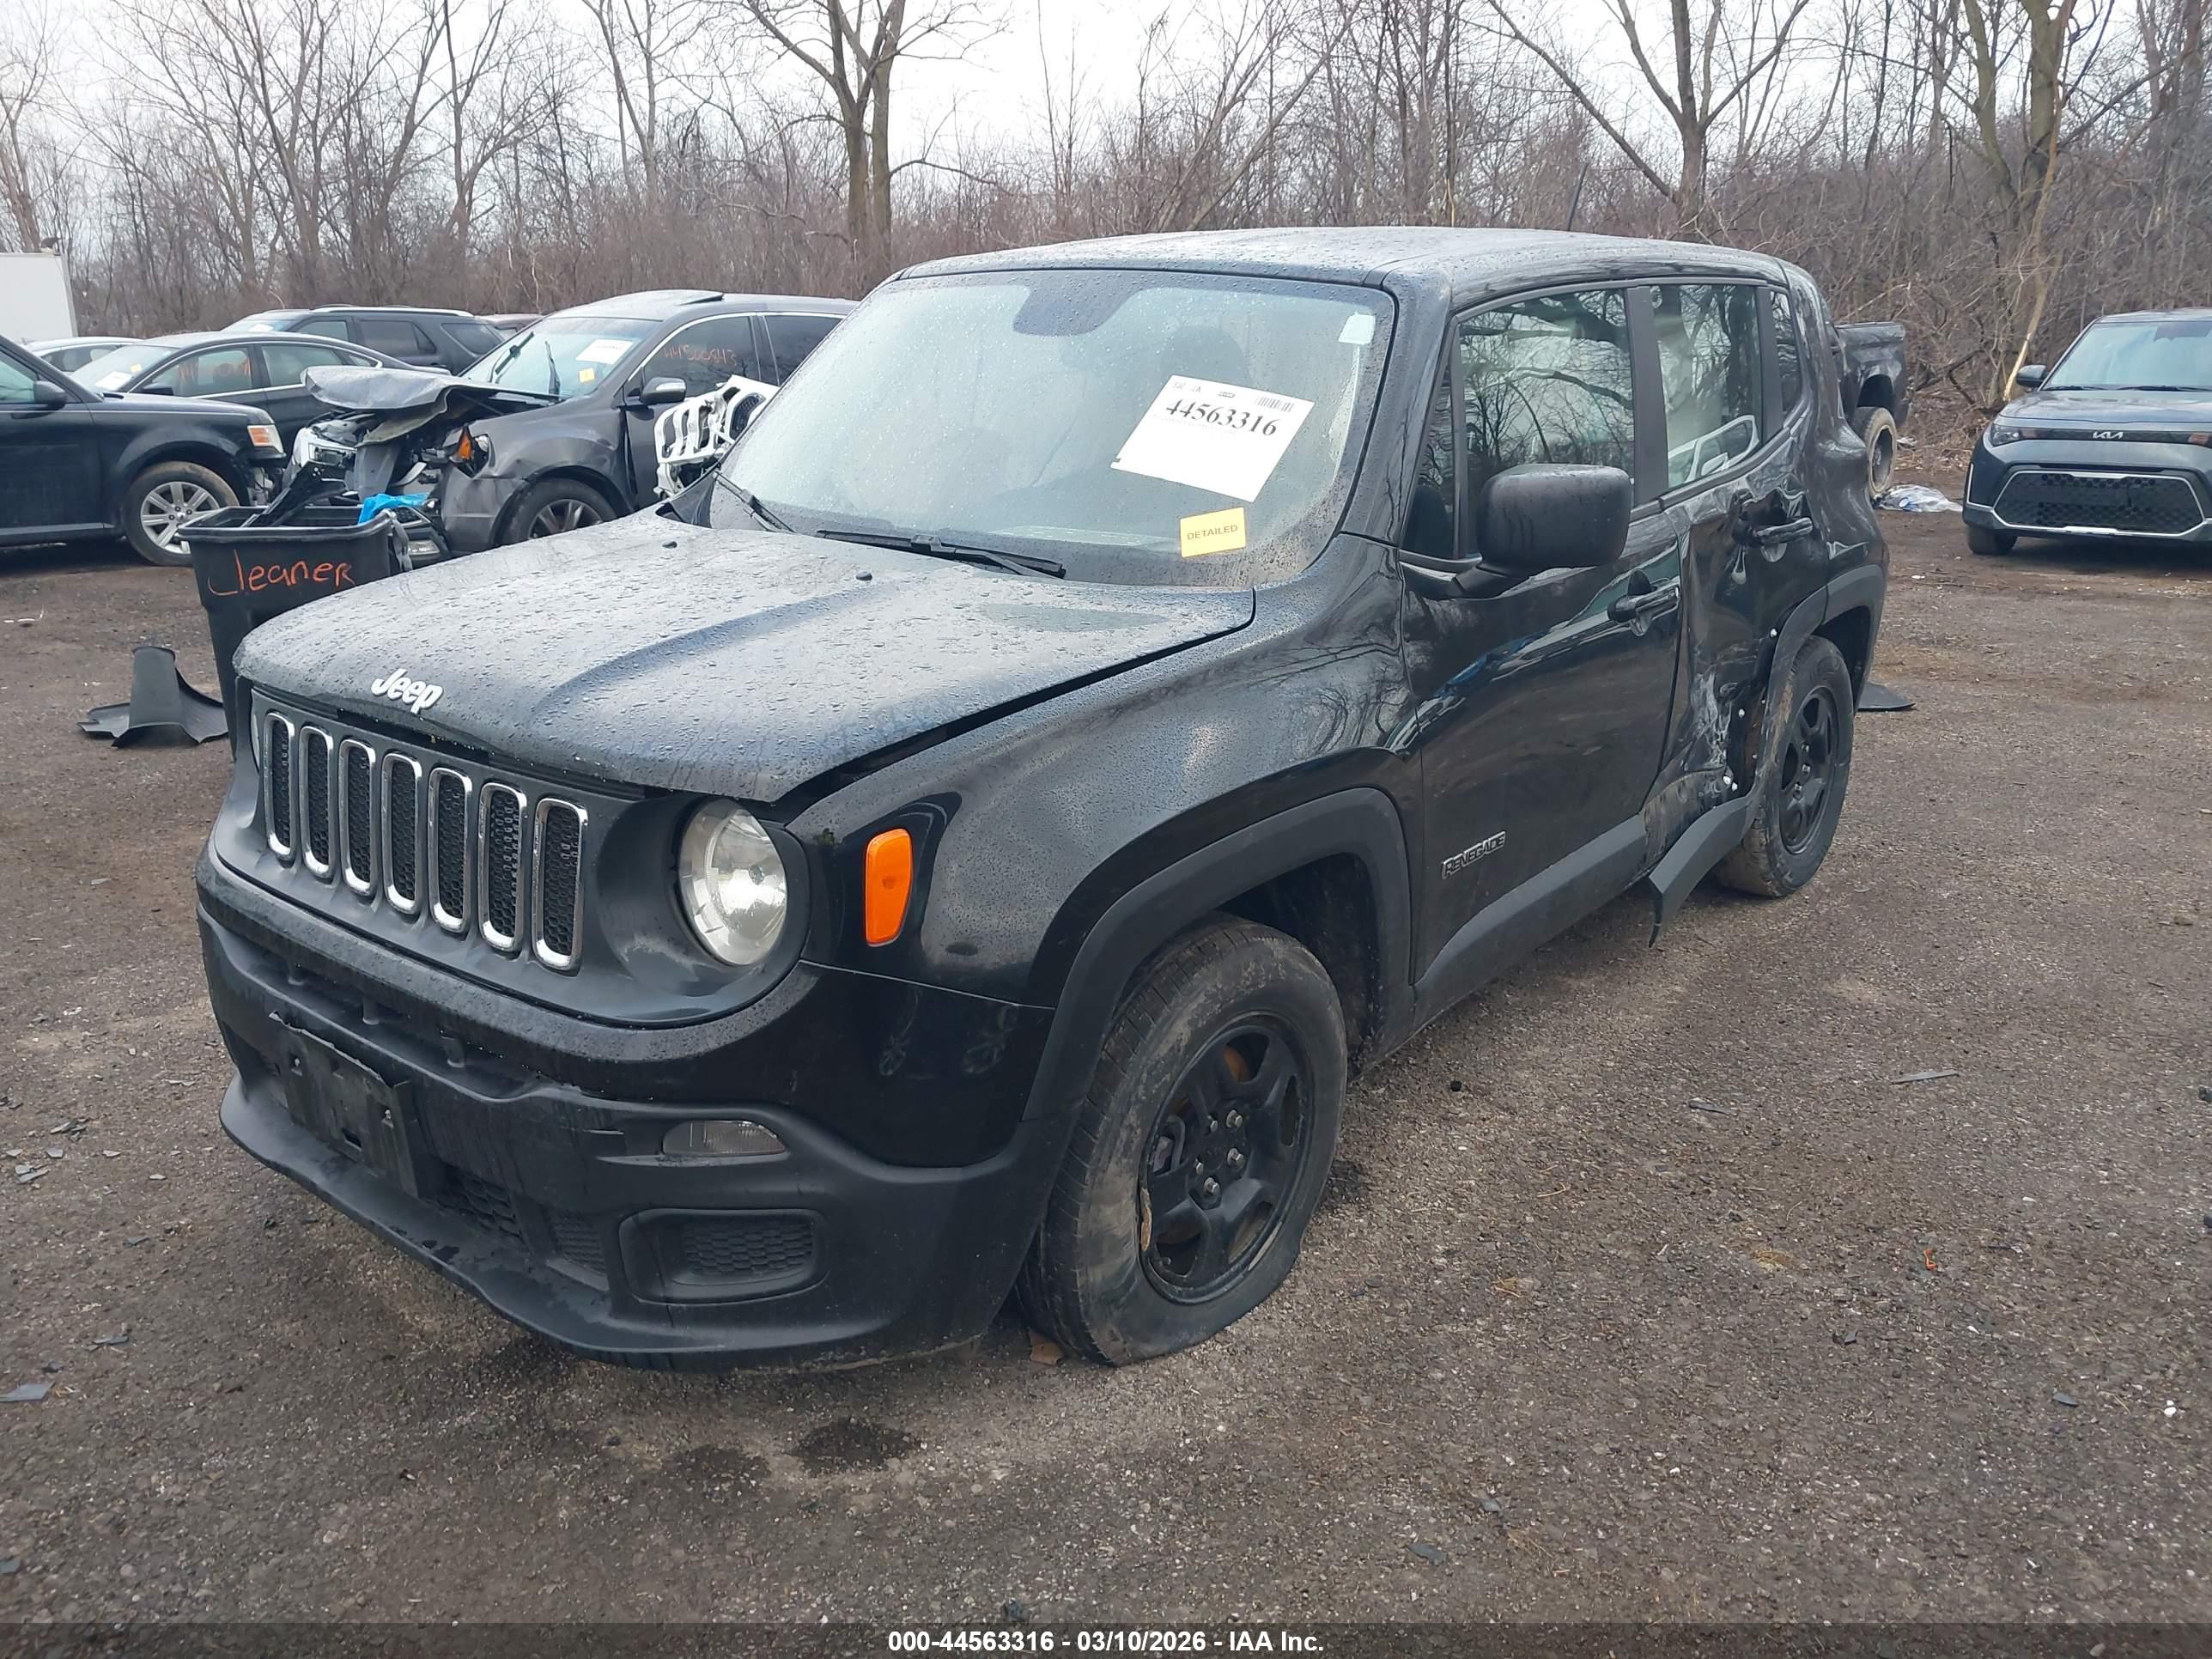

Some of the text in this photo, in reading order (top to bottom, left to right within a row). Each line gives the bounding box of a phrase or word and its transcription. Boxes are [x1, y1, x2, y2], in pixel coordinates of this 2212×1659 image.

[1166, 399, 1282, 436] 44563316
[2093, 431, 2124, 440] KIA
[1187, 524, 1238, 540] DETAILED
[371, 668, 444, 715] Jeep
[1442, 830, 1505, 879] RENEGADE
